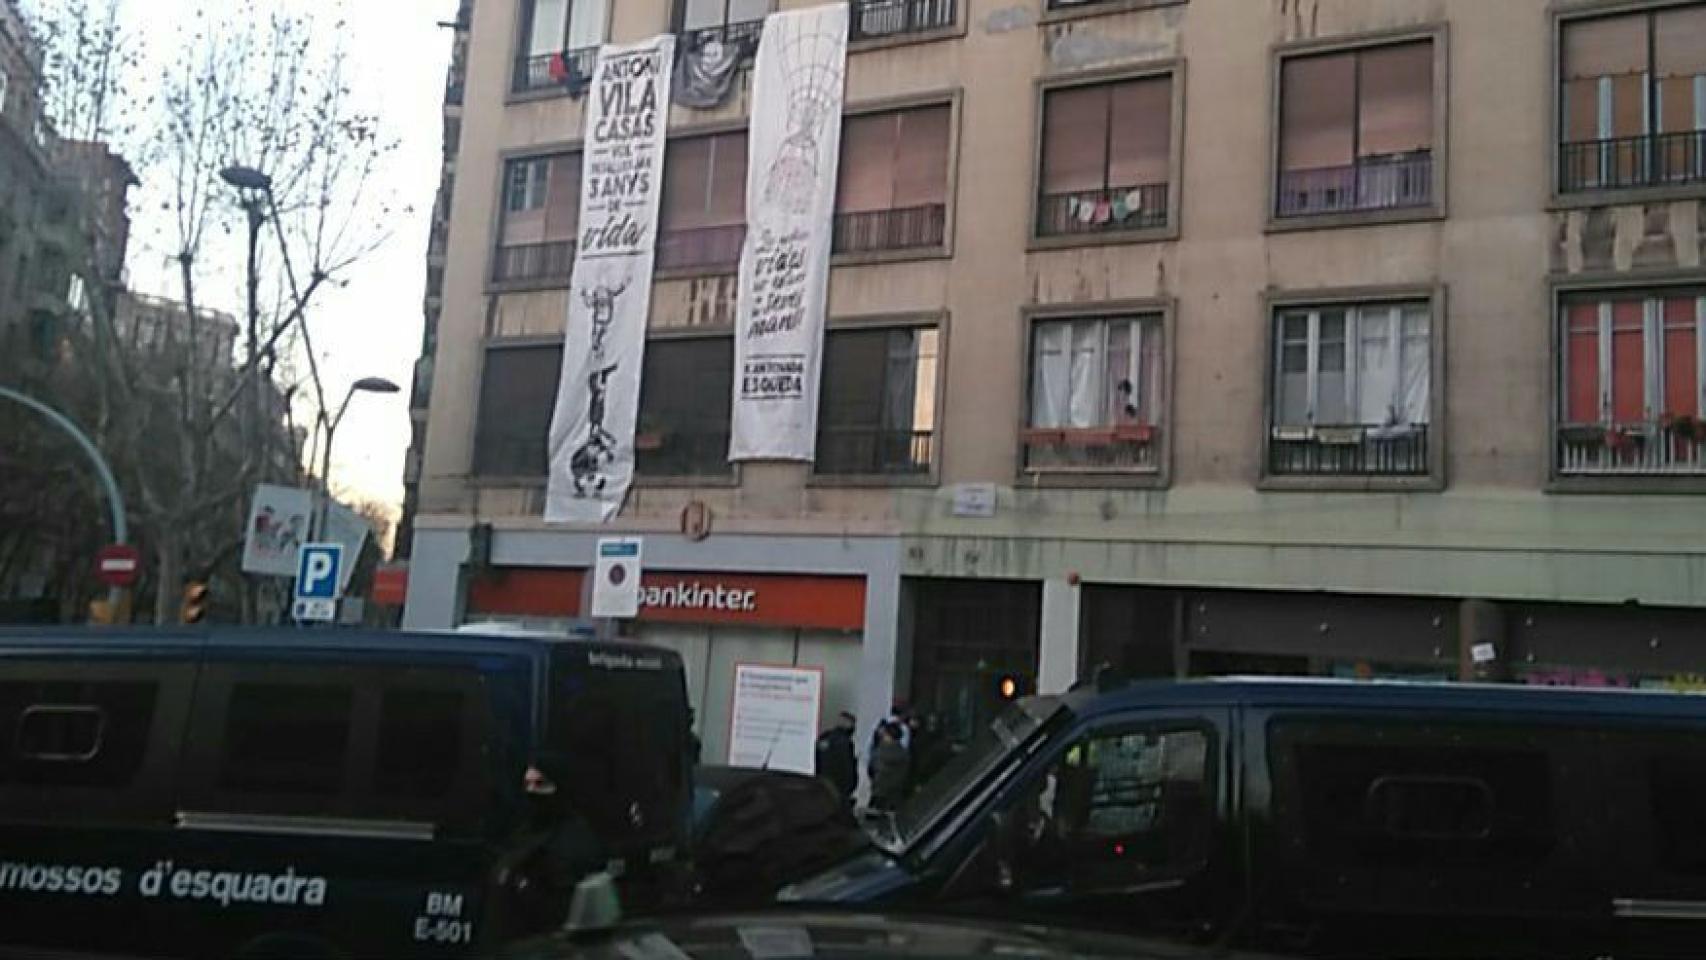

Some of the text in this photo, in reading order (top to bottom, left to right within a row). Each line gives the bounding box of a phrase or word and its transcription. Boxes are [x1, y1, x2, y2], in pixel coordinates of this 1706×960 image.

[600, 80, 656, 117] VILA
[595, 114, 654, 142] CASAS
[601, 172, 649, 196] ANYS
[581, 213, 648, 251] vida
[305, 552, 331, 593] P
[0, 860, 327, 907] mossos d'esquadra
[426, 893, 463, 915] BM
[414, 917, 471, 944] E-501
